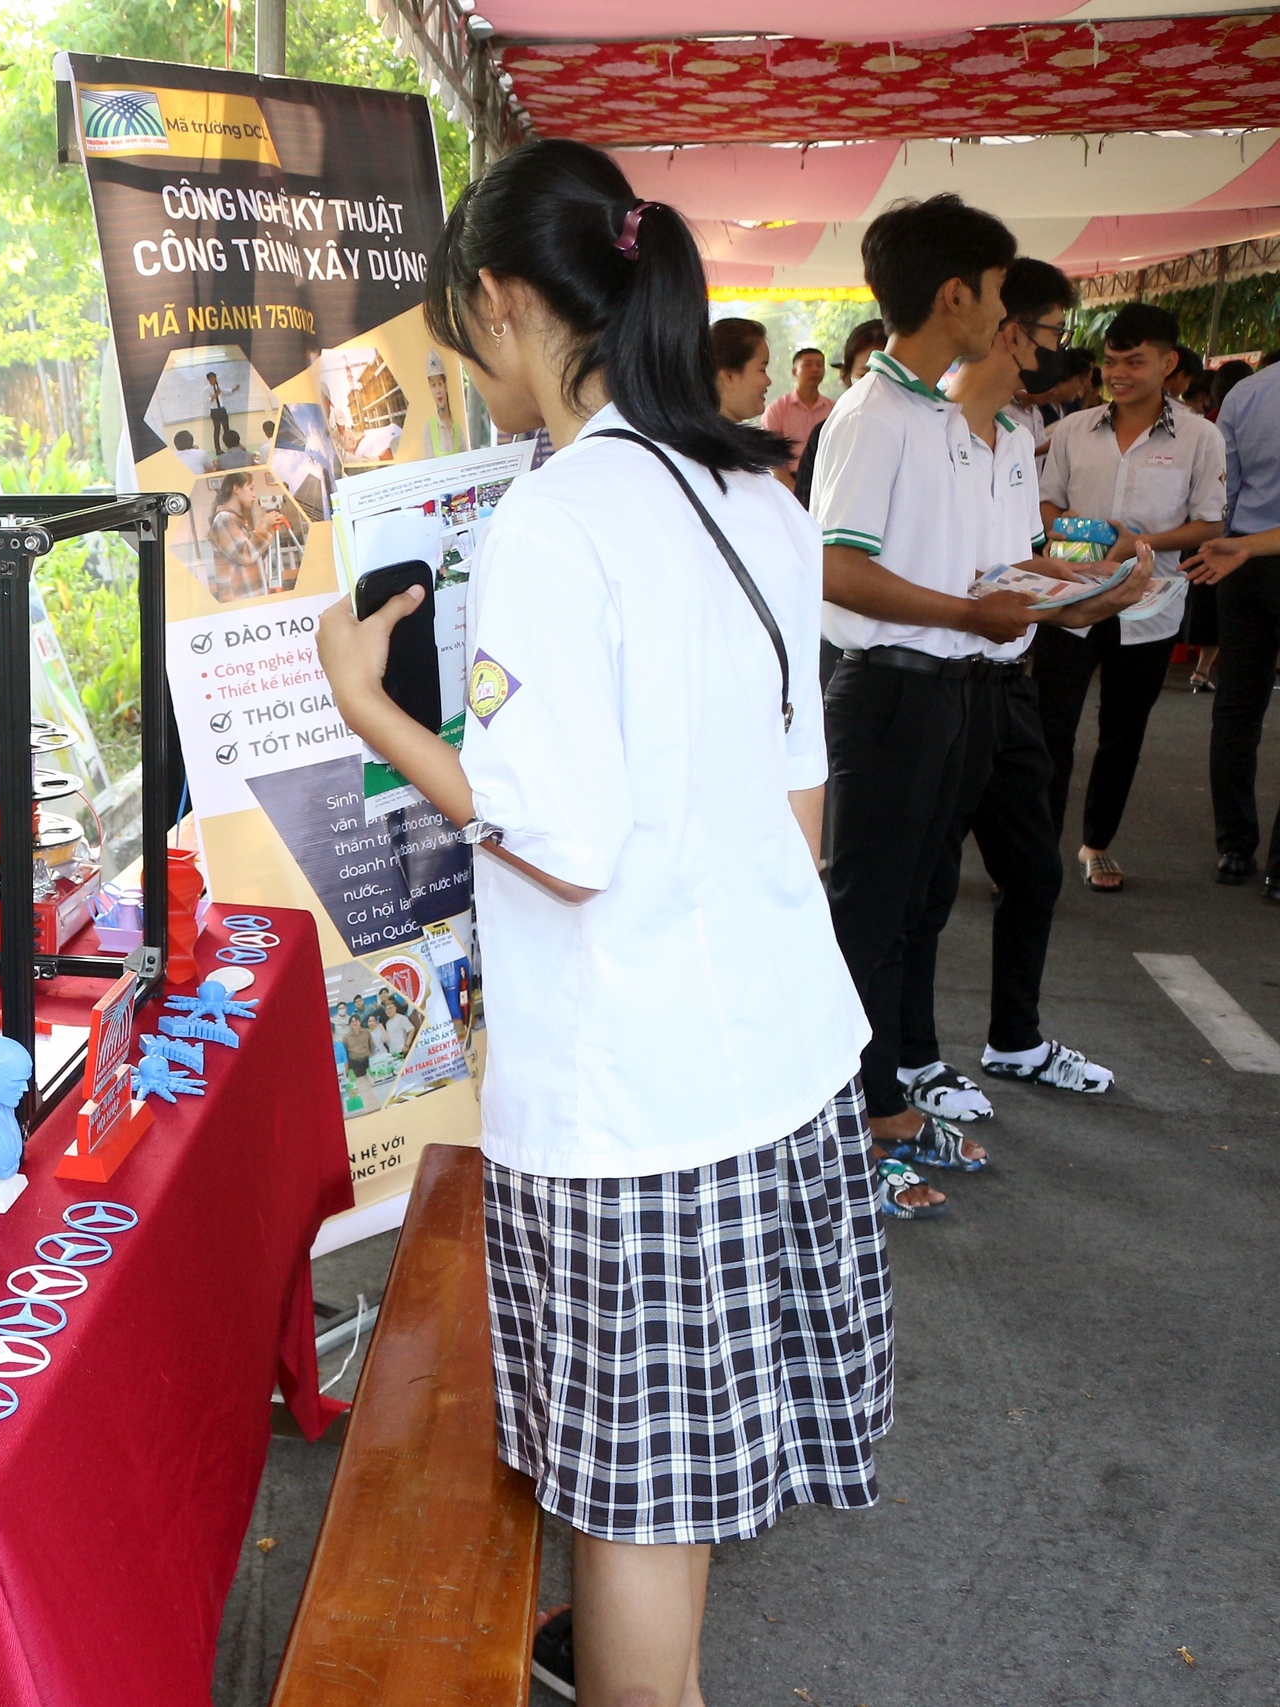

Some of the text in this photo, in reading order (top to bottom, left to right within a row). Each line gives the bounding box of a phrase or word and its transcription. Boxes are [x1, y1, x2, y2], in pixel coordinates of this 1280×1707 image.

[166, 118, 269, 141] Mã trường DCL
[161, 178, 403, 242] CÔNG NGHỆ KỸ THUẬT
[132, 229, 427, 290] CÔNG TRÌNH XÂY DỰNG
[138, 303, 181, 340] MÃ
[187, 300, 263, 332] NGÀNH
[224, 616, 315, 648] ĐÀO TẠO
[214, 647, 313, 678] Công nghệ kỹ
[217, 679, 258, 699] Thiết
[261, 674, 279, 692] kế
[281, 669, 312, 687] kiến
[243, 700, 295, 726] THỜI
[248, 731, 290, 757] TỐT
[326, 792, 359, 810] Sinh
[330, 818, 358, 833] văn
[401, 816, 418, 833] cho
[418, 814, 443, 829] công
[421, 838, 437, 851] xây
[439, 830, 461, 846] dựng
[339, 858, 386, 880] doanh
[347, 910, 368, 925] Cơ
[372, 900, 395, 919] hội
[429, 877, 451, 894] nước
[351, 930, 381, 949] Hàn
[428, 1041, 451, 1056] ASCENT
[361, 1143, 378, 1160] HỆ
[382, 1135, 405, 1152] VỚI
[379, 1154, 401, 1170] TÔI
